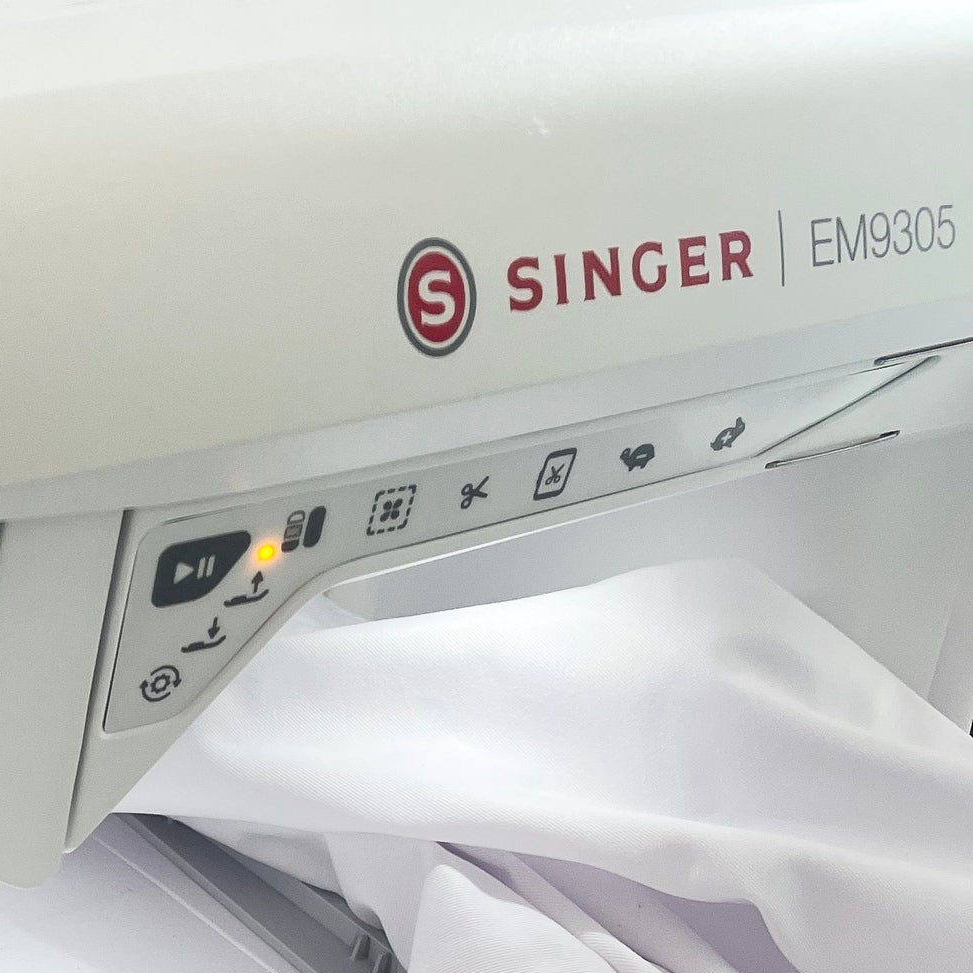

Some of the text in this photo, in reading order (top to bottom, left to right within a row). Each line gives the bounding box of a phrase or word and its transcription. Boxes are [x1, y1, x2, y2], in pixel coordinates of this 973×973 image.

[418, 270, 453, 326] S
[507, 204, 957, 312] SINGER EM9305
